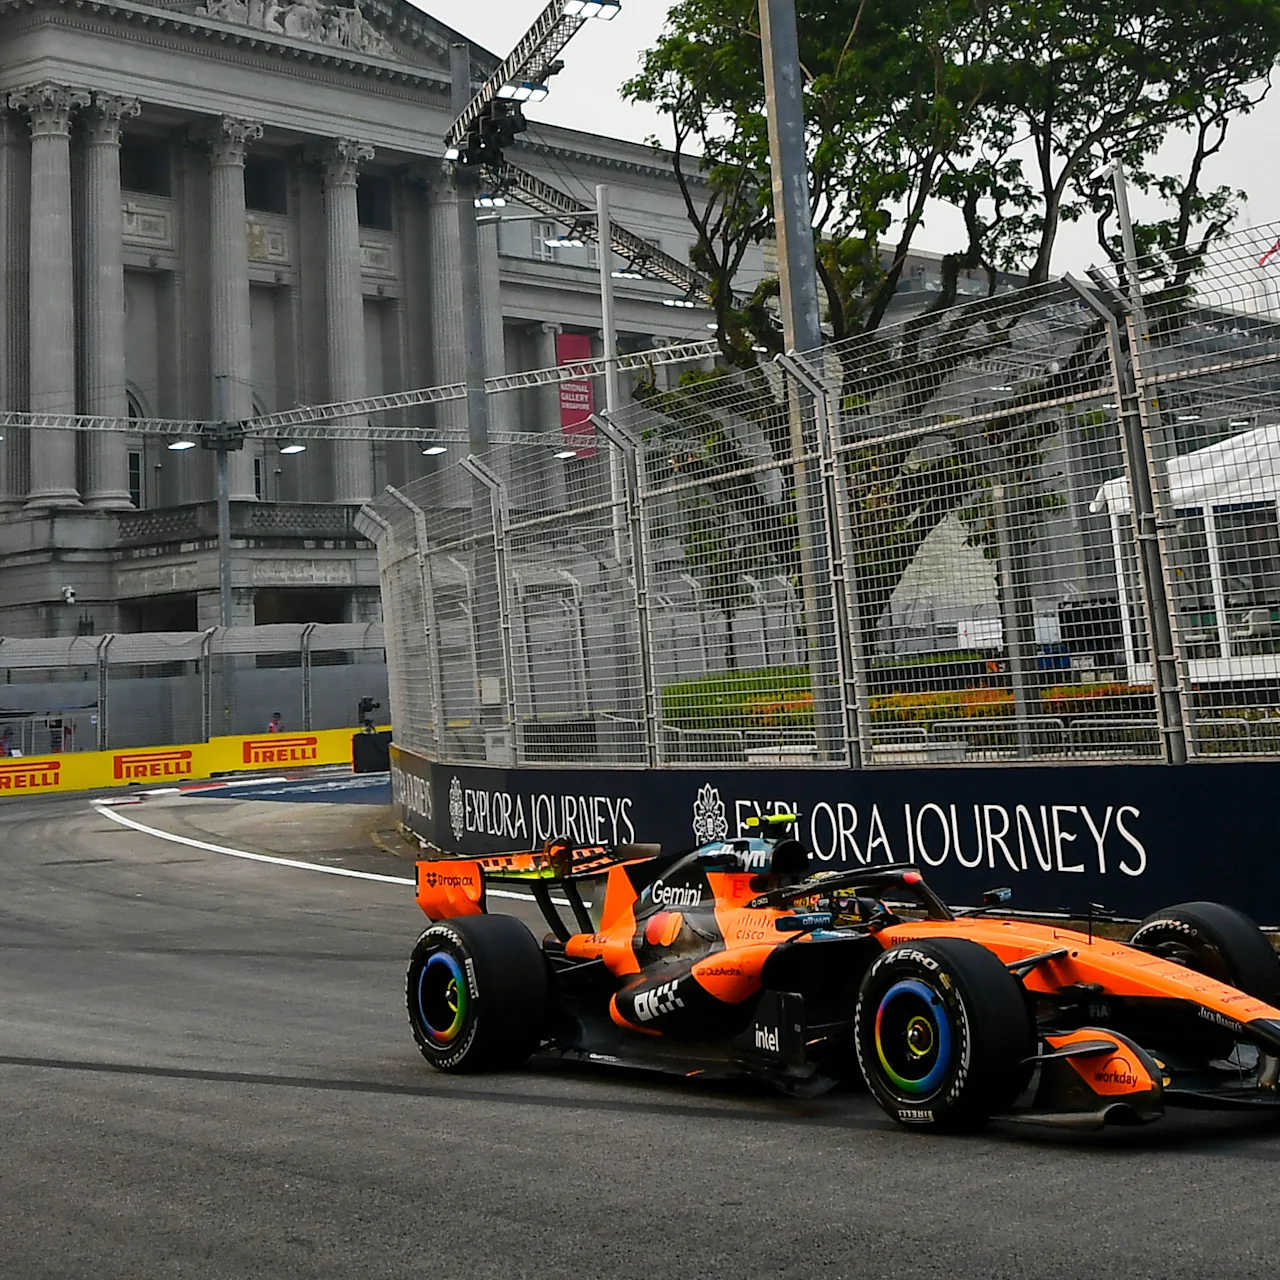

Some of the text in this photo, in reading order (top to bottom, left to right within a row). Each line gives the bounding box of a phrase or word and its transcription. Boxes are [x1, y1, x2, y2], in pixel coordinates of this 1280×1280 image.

[560, 384, 589, 392] NATIONAL
[561, 393, 589, 403] GALLERY
[243, 736, 317, 764] PIRELLI
[113, 750, 192, 779] PIRELLI
[465, 789, 636, 851] EXPLORA JOURNEYS
[904, 803, 1147, 876] JOURNEYS
[651, 879, 703, 907] Gemini
[884, 948, 939, 970] ZERO
[755, 1023, 779, 1052] intel
[1094, 1070, 1139, 1088] workday
[898, 1109, 935, 1123] PIRELLI
